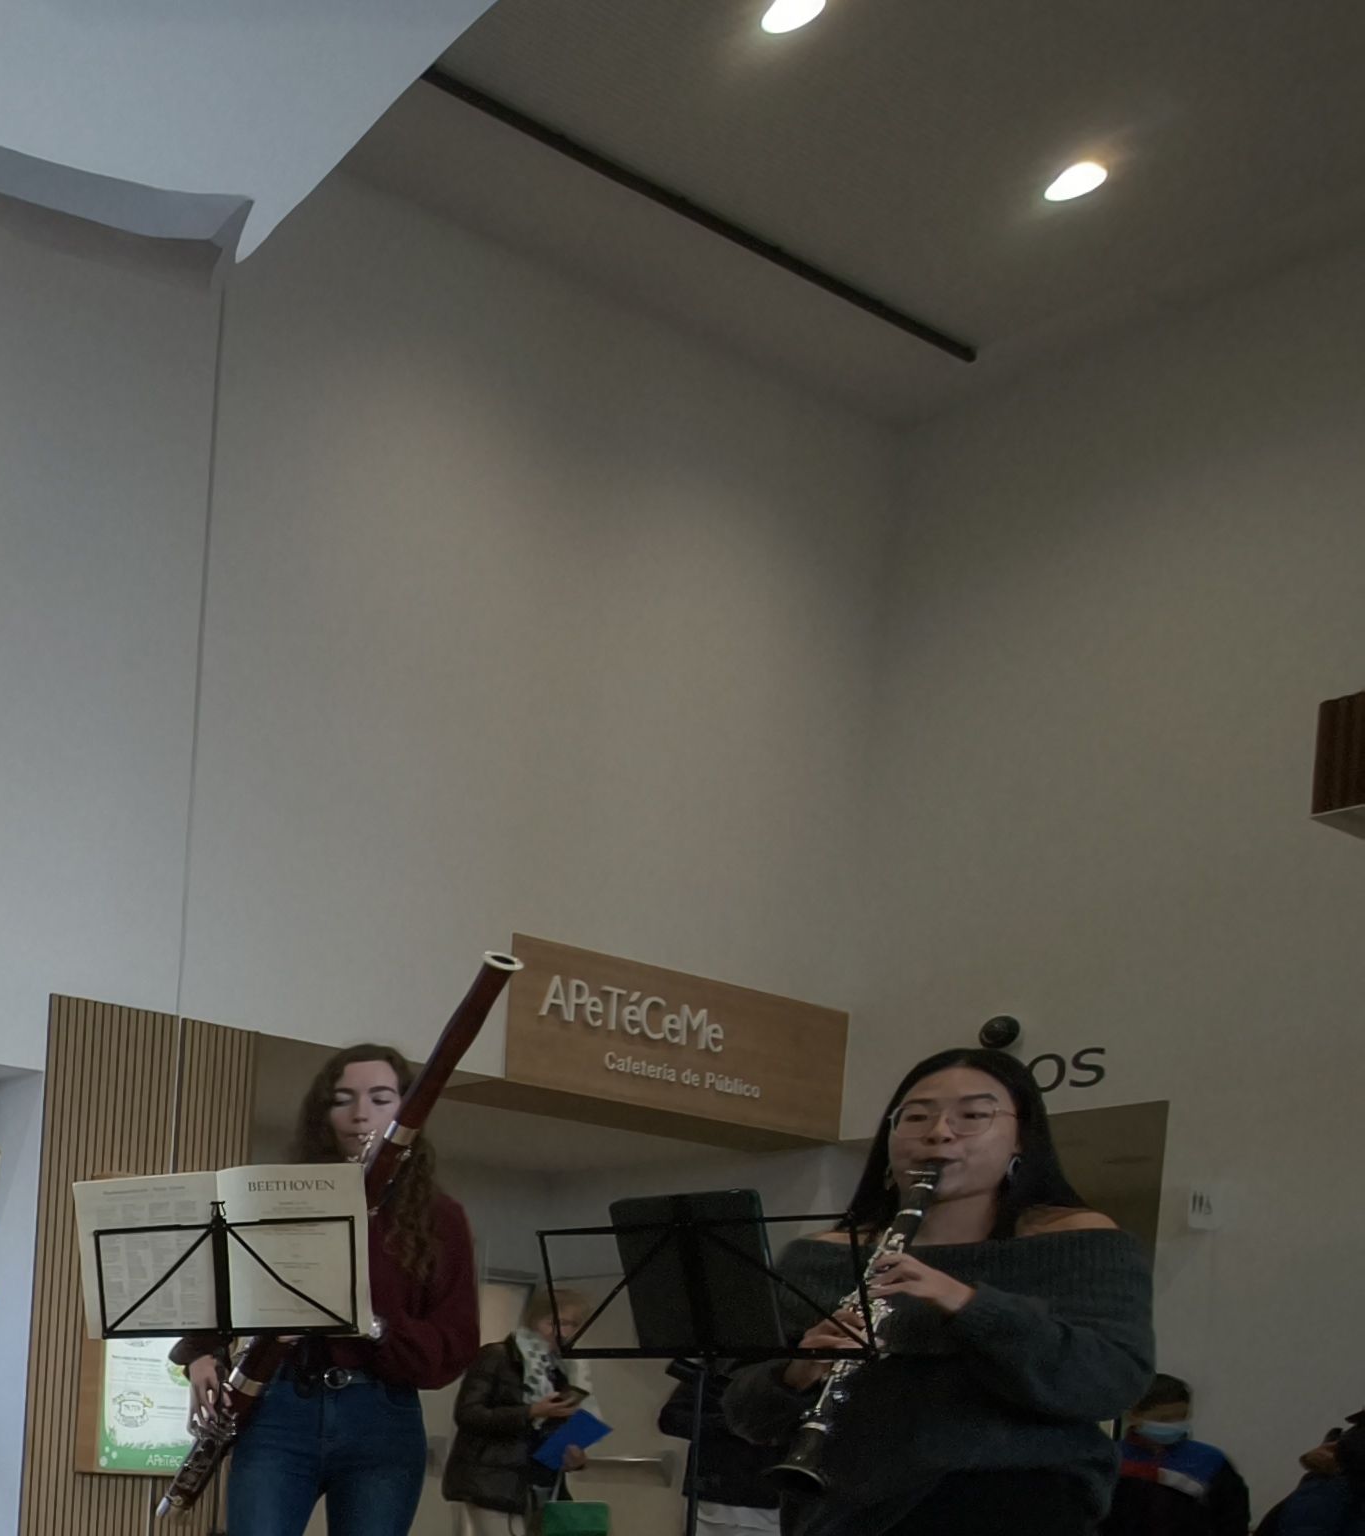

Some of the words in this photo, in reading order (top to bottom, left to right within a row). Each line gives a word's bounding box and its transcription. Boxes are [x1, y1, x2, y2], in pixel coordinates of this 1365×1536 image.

[539, 974, 725, 1052] APeTéCeMe
[604, 1051, 677, 1083] Cafetería
[681, 1068, 701, 1087] de
[704, 1071, 762, 1099] Público
[248, 1179, 336, 1193] BEETHOVEN
